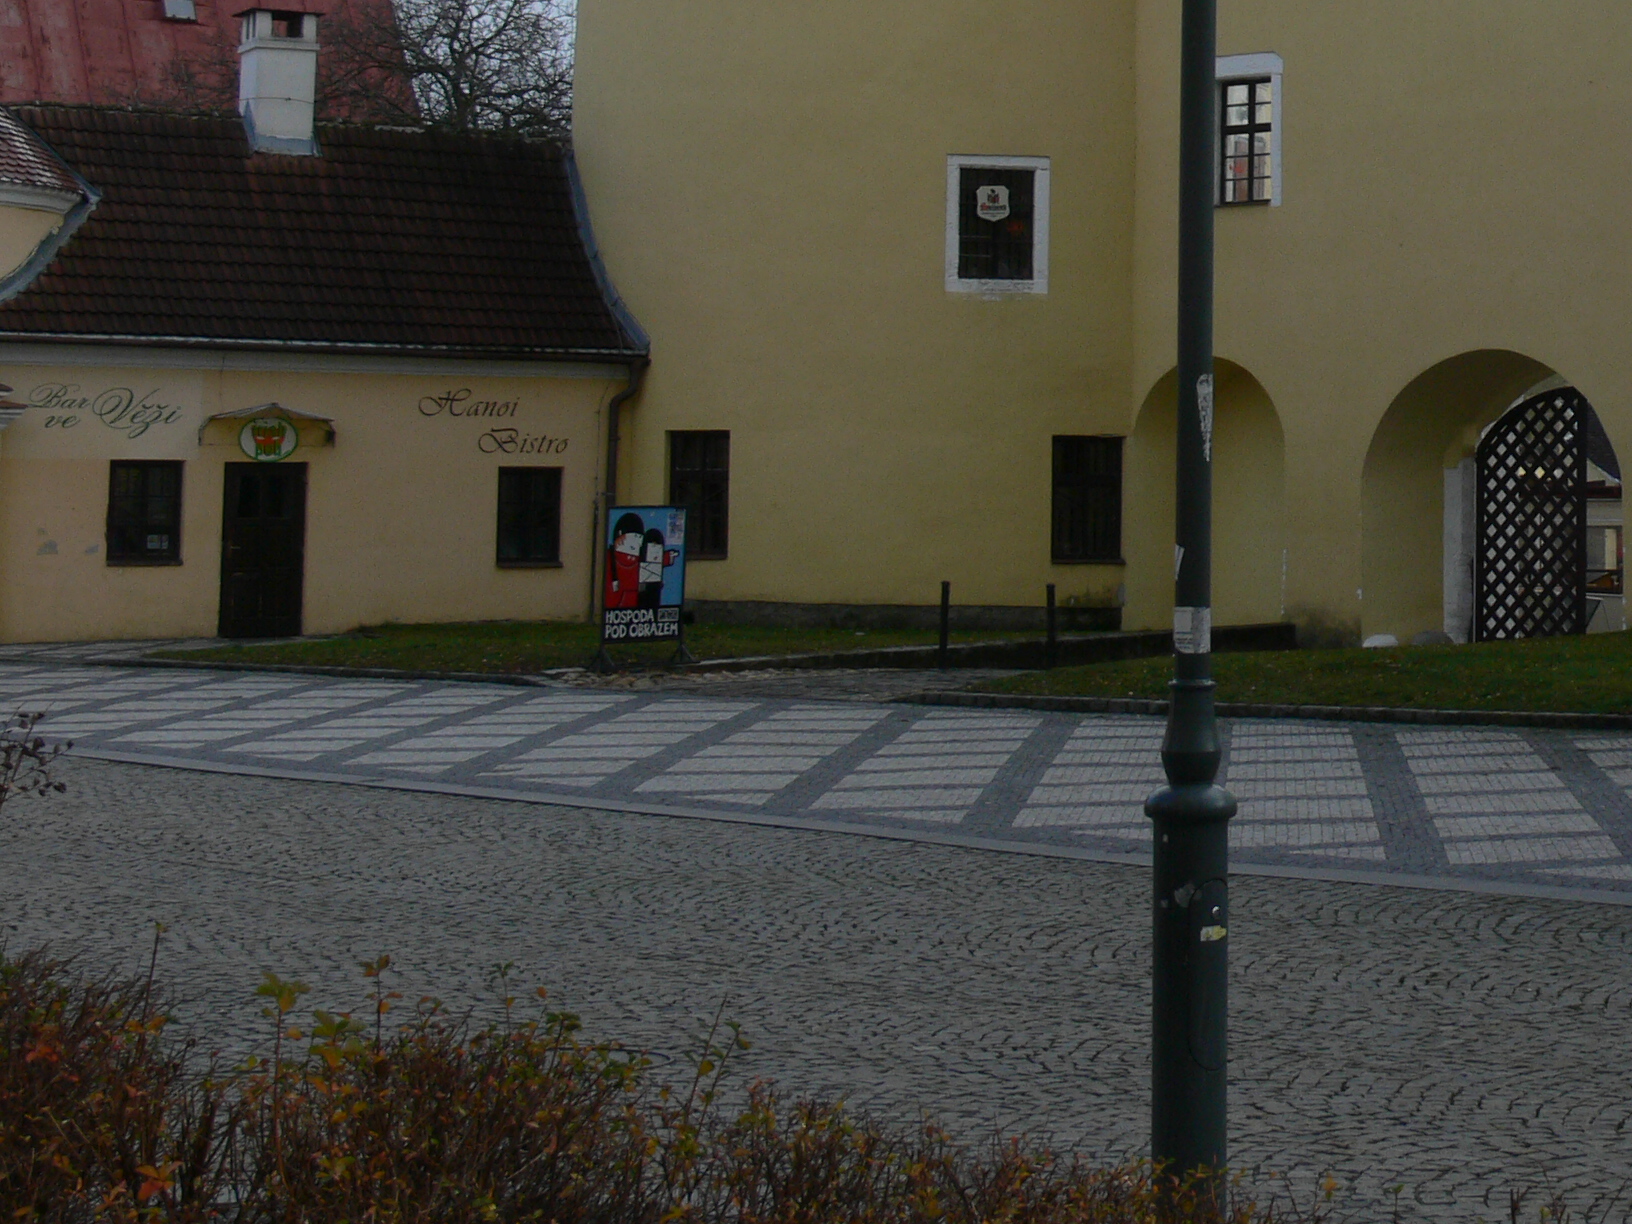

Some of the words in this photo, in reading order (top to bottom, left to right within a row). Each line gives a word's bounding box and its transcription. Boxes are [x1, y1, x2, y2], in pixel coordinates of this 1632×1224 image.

[30, 382, 91, 409] Bar
[418, 388, 521, 417] Hanoi
[44, 415, 81, 429] ve
[92, 387, 183, 439] Věži
[478, 427, 570, 454] Bistro
[605, 609, 655, 624] HOSPODA
[605, 624, 628, 639] POD
[629, 622, 679, 637] OBRAZEM
